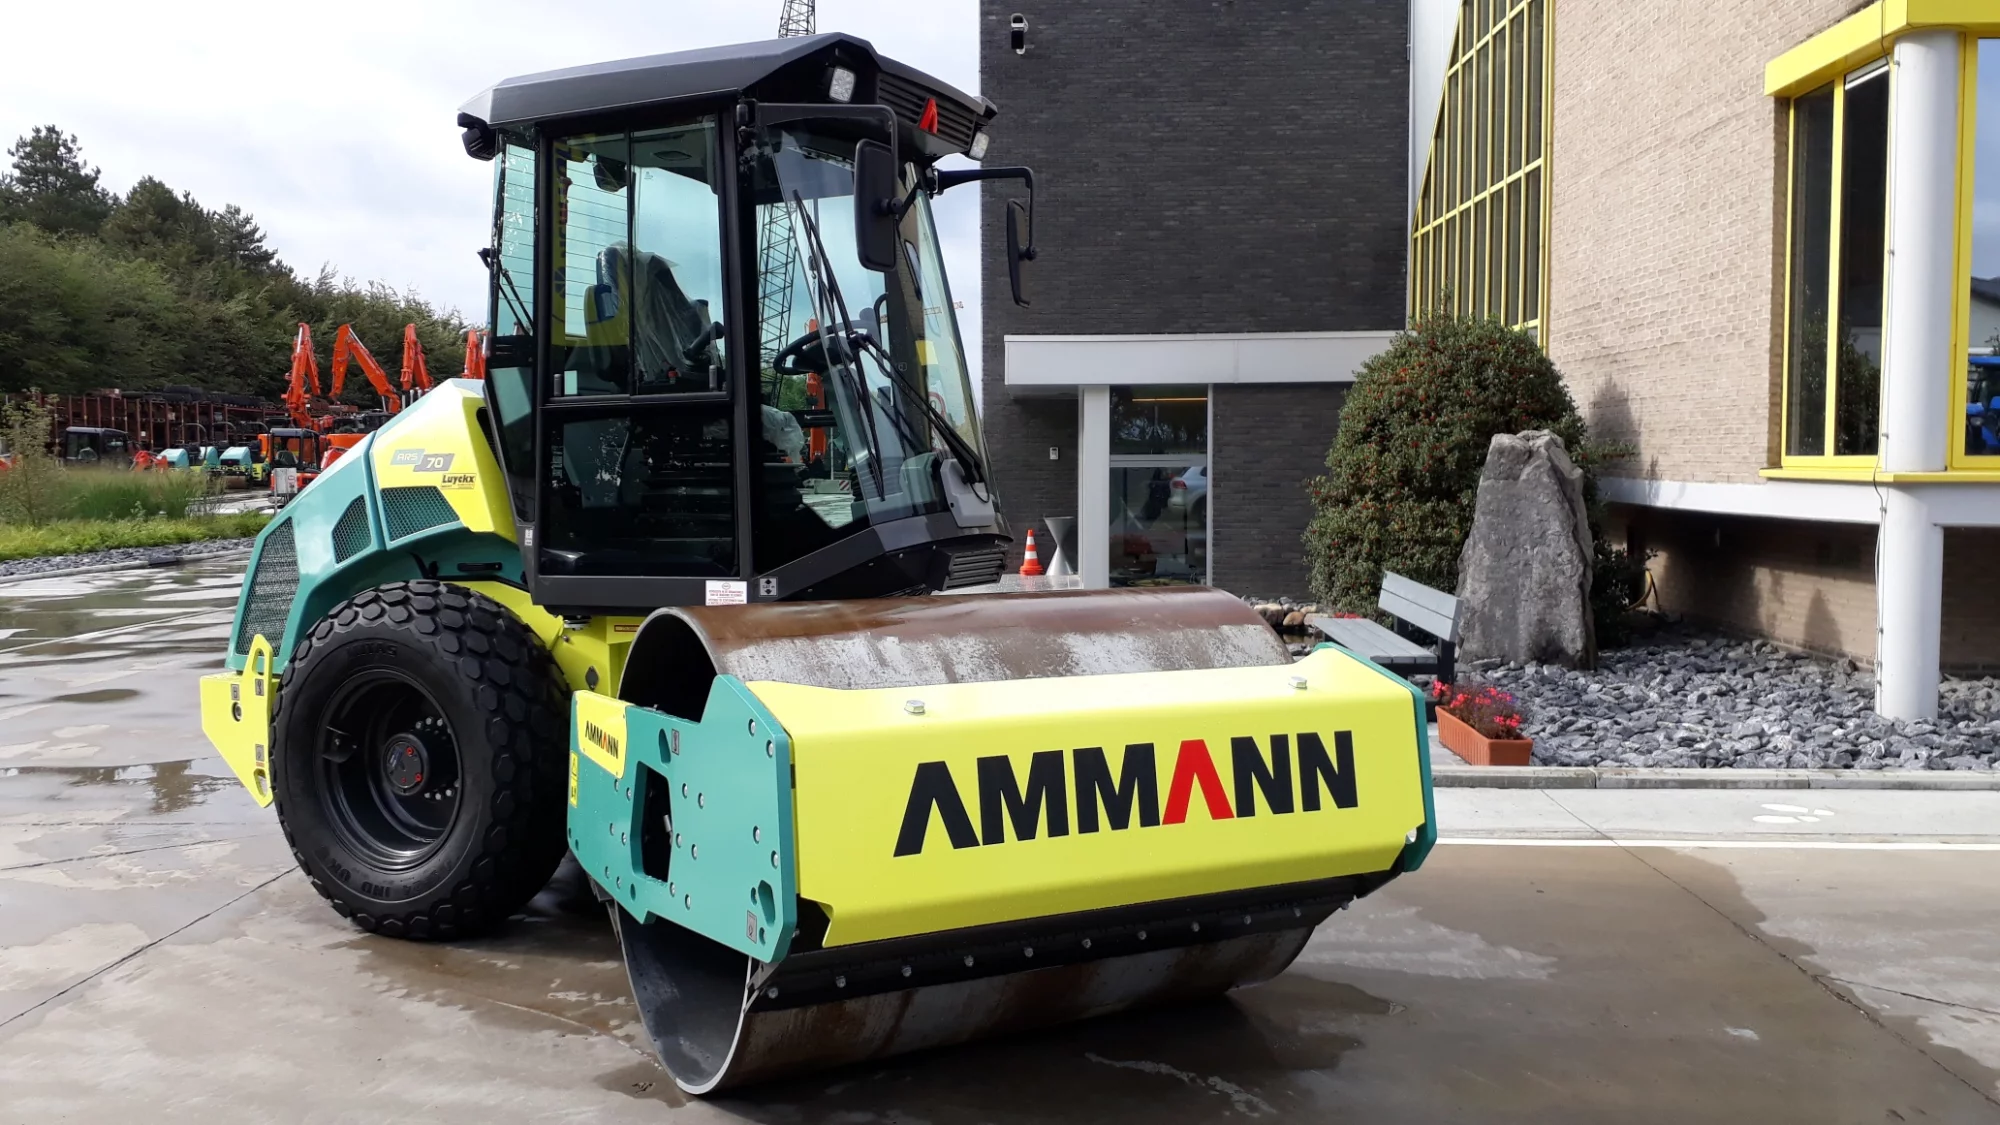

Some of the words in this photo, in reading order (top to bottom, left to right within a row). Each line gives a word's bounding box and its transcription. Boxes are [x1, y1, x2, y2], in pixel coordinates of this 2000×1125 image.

[396, 453, 419, 461] ARS
[426, 457, 444, 469] 70
[442, 474, 475, 485] Luyckx
[585, 720, 619, 760] AMMANN
[893, 730, 1359, 857] AMMANN
